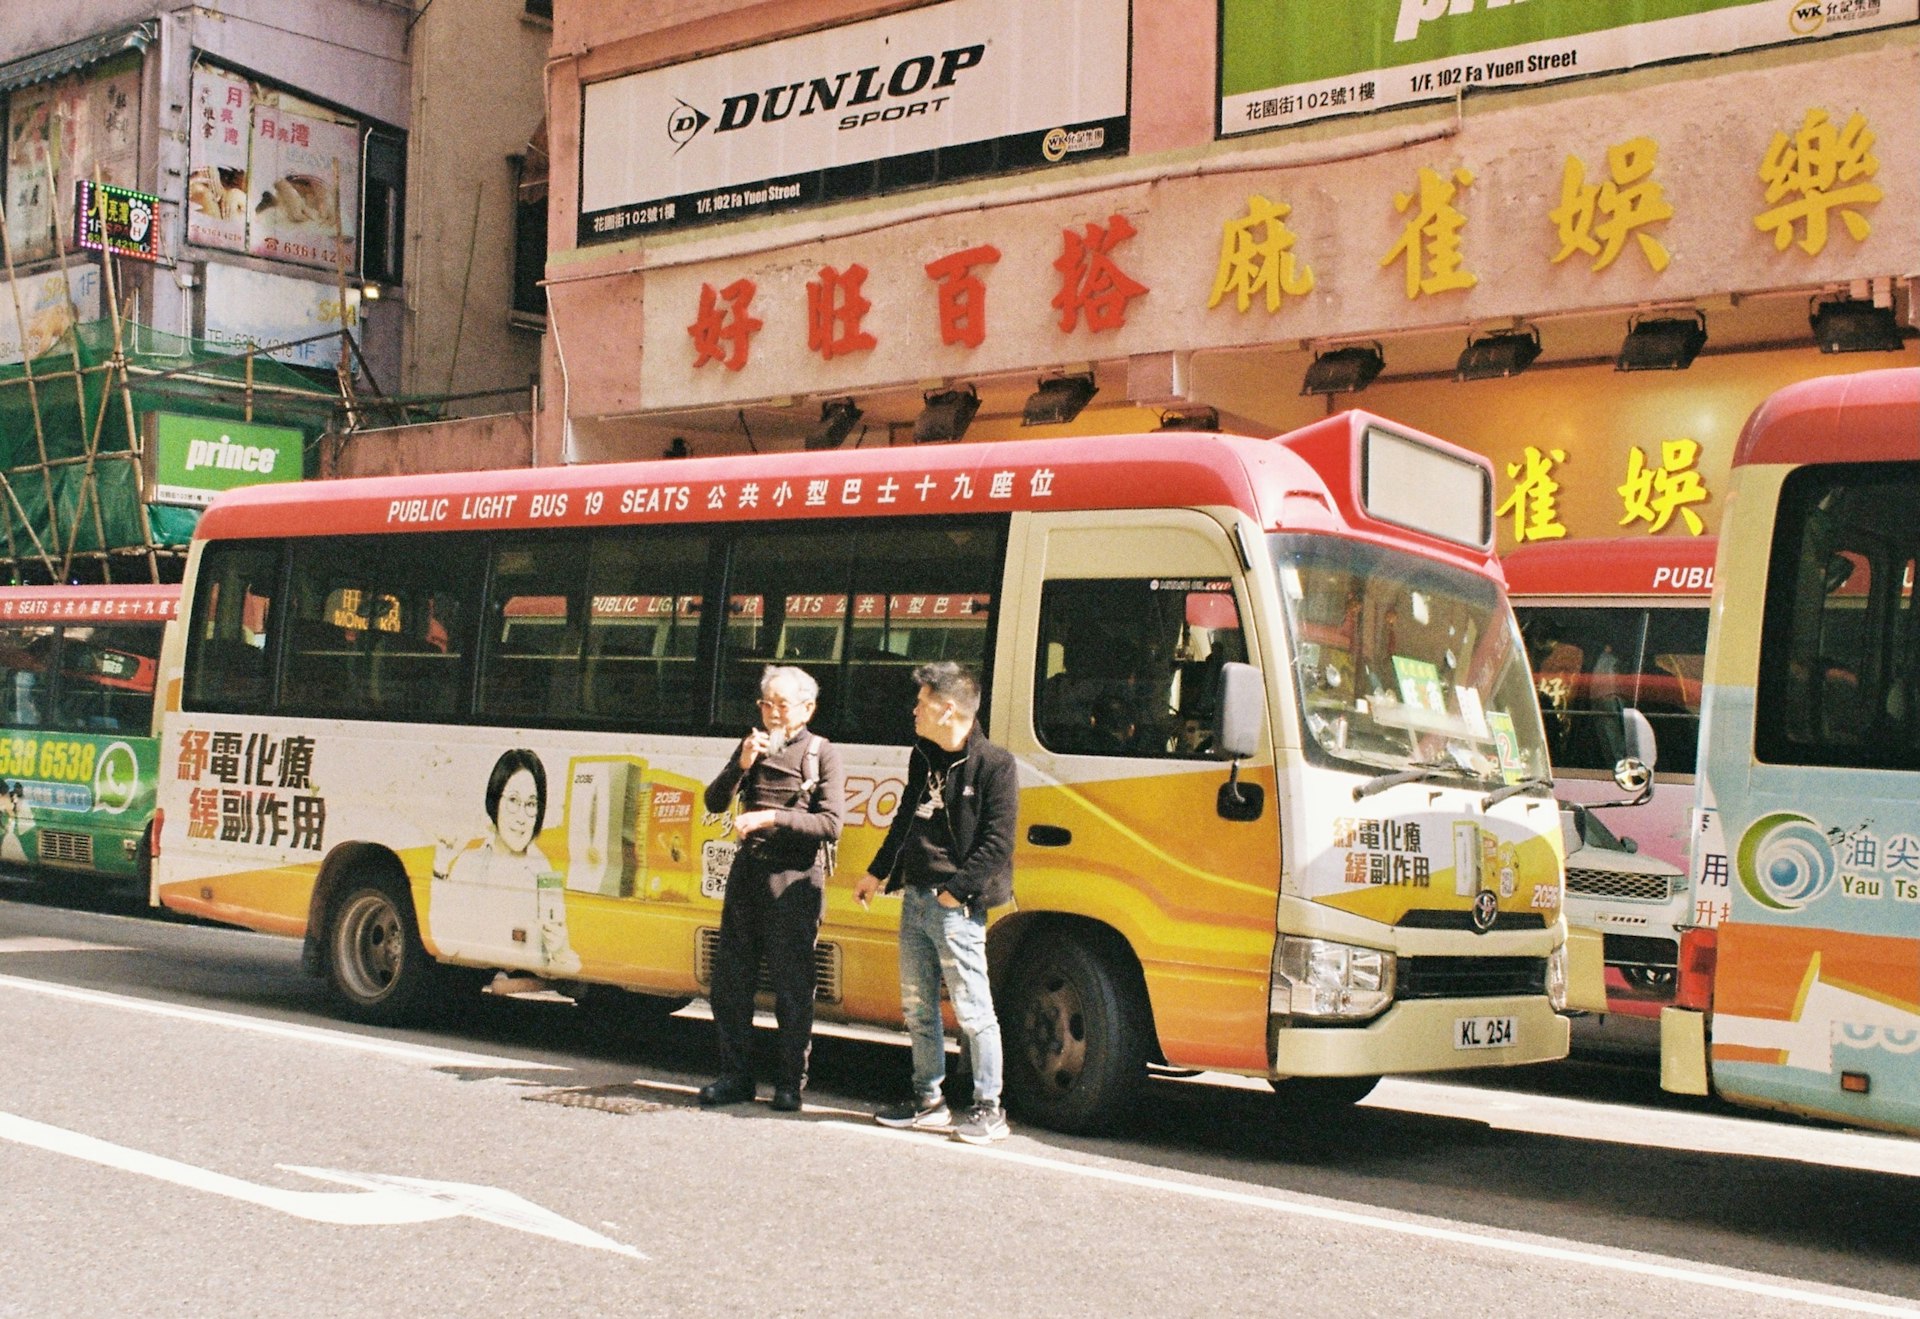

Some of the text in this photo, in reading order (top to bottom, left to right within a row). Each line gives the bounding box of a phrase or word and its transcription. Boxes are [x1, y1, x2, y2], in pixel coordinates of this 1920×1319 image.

[713, 43, 986, 134] DUNLOP
[1410, 50, 1577, 93] 1/F, 102 Fa Yuen Street
[837, 96, 951, 131] SPORT
[1246, 81, 1375, 120] 花園街102號1樓
[744, 188, 768, 205] Yuen
[768, 182, 801, 200] Street
[133, 213, 147, 225] 24
[133, 226, 141, 237] H
[320, 248, 352, 266] 428
[185, 434, 276, 474] prince
[387, 468, 1056, 523] PUBLIC LIGHT BUS 19 SEATS 公共小型巴士十九座位
[1495, 438, 1708, 543] 雀娛
[18, 601, 48, 614] SEATS
[40, 741, 96, 781] 6538
[187, 787, 326, 851] 緩副作用
[1843, 876, 1880, 896] Yau
[1462, 1020, 1512, 1044] KL 254
